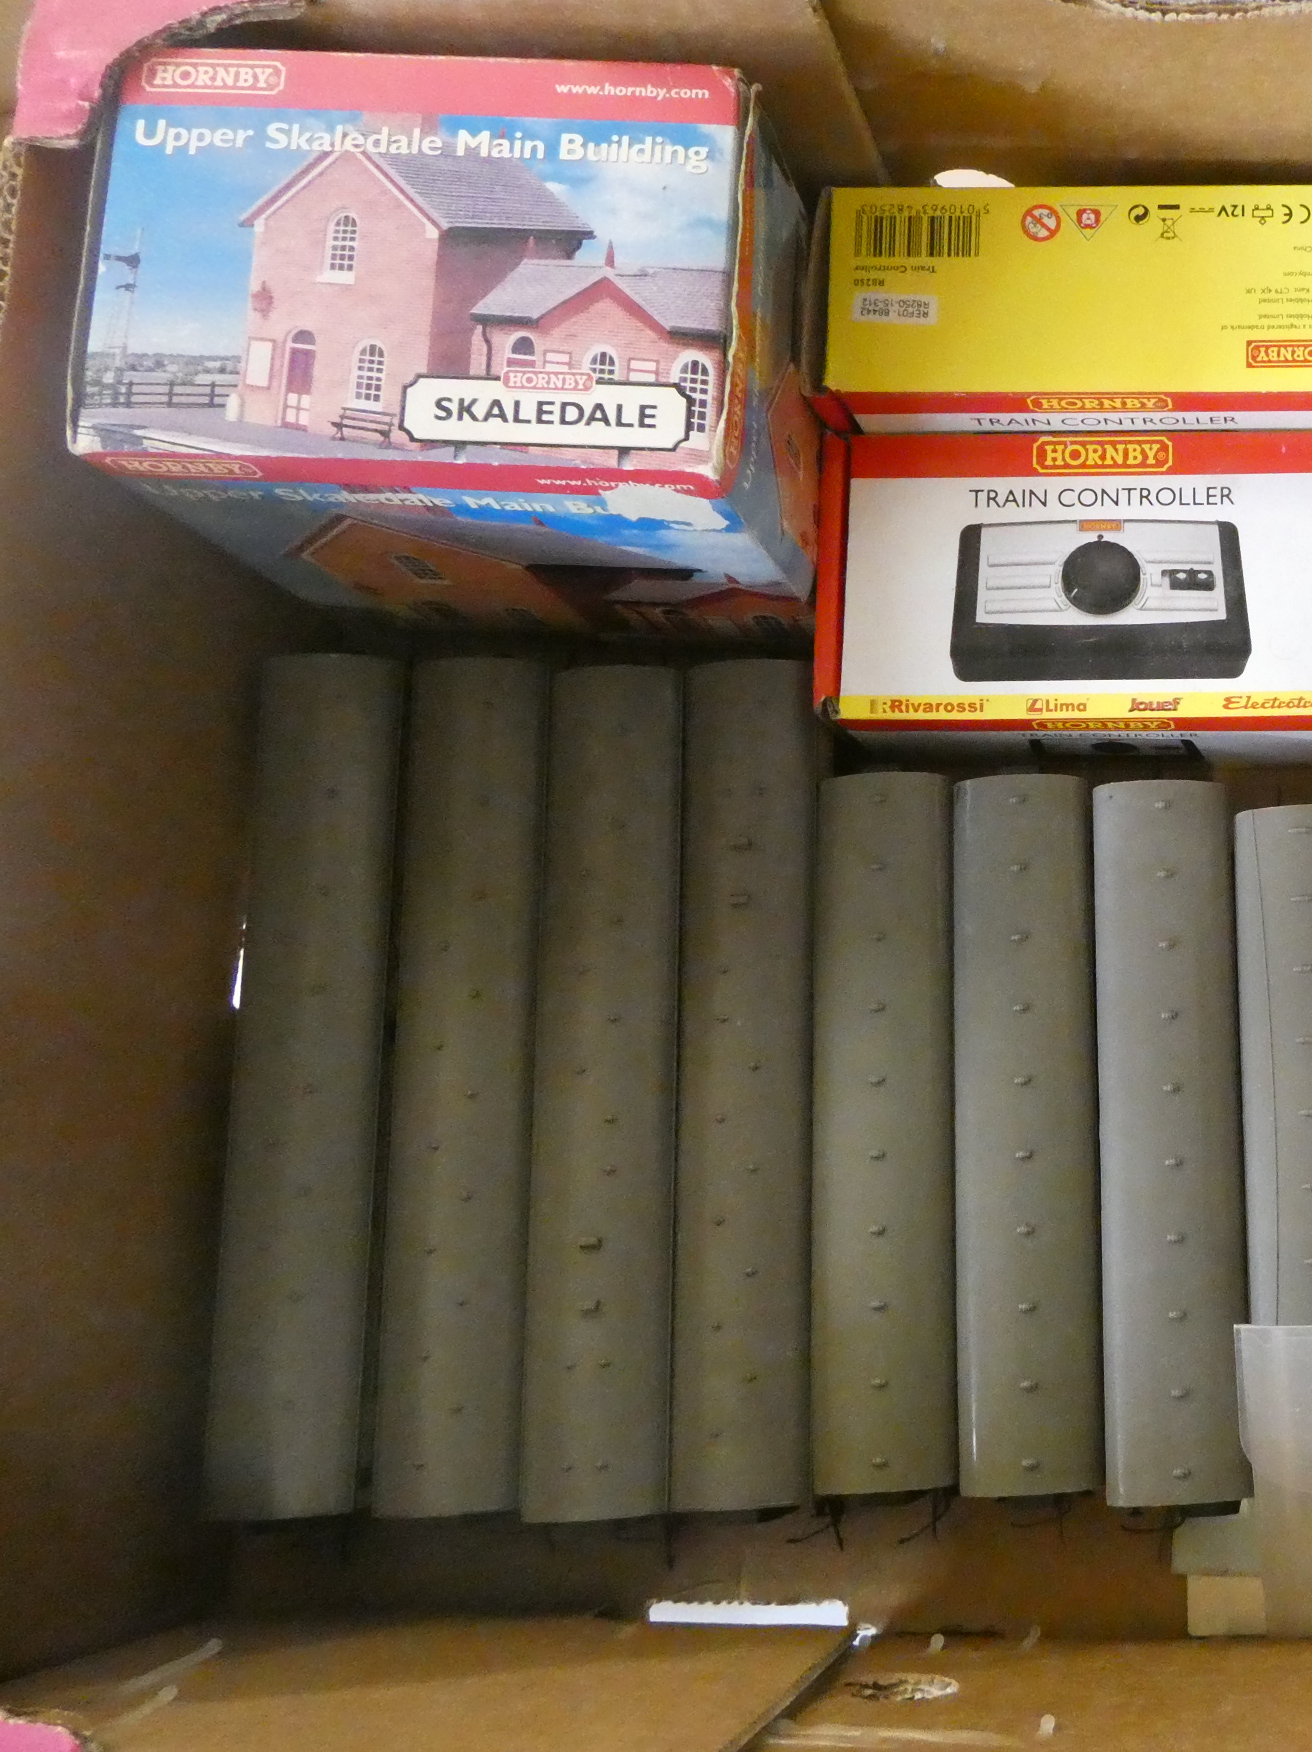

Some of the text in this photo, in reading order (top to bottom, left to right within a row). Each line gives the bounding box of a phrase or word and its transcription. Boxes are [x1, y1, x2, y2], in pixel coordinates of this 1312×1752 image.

[153, 64, 275, 90] HORNBY
[555, 81, 710, 101] www.hornby.com
[135, 117, 710, 174] Upper Skaledale Main Building
[1217, 204, 1246, 218] 12V
[853, 264, 938, 274] Train Controller
[507, 372, 589, 390] HORNBY
[433, 396, 658, 429] SKALEDALE
[1039, 397, 1158, 410] HORNBY
[970, 415, 1239, 427] TRAIN CONTROLLER
[1045, 443, 1160, 466] HORNBY
[124, 459, 243, 476] HORNBY
[142, 482, 265, 502] Upper
[275, 486, 457, 508] Skaledale
[462, 495, 556, 514] Main
[968, 486, 1236, 509] TRAIN CONTROLLER
[889, 698, 985, 714] Rivarossi
[1045, 699, 1087, 713] Lima
[1128, 696, 1184, 712] Jouef
[1044, 720, 1160, 730] HORNBY
[1076, 731, 1200, 739] CONTROLLER
